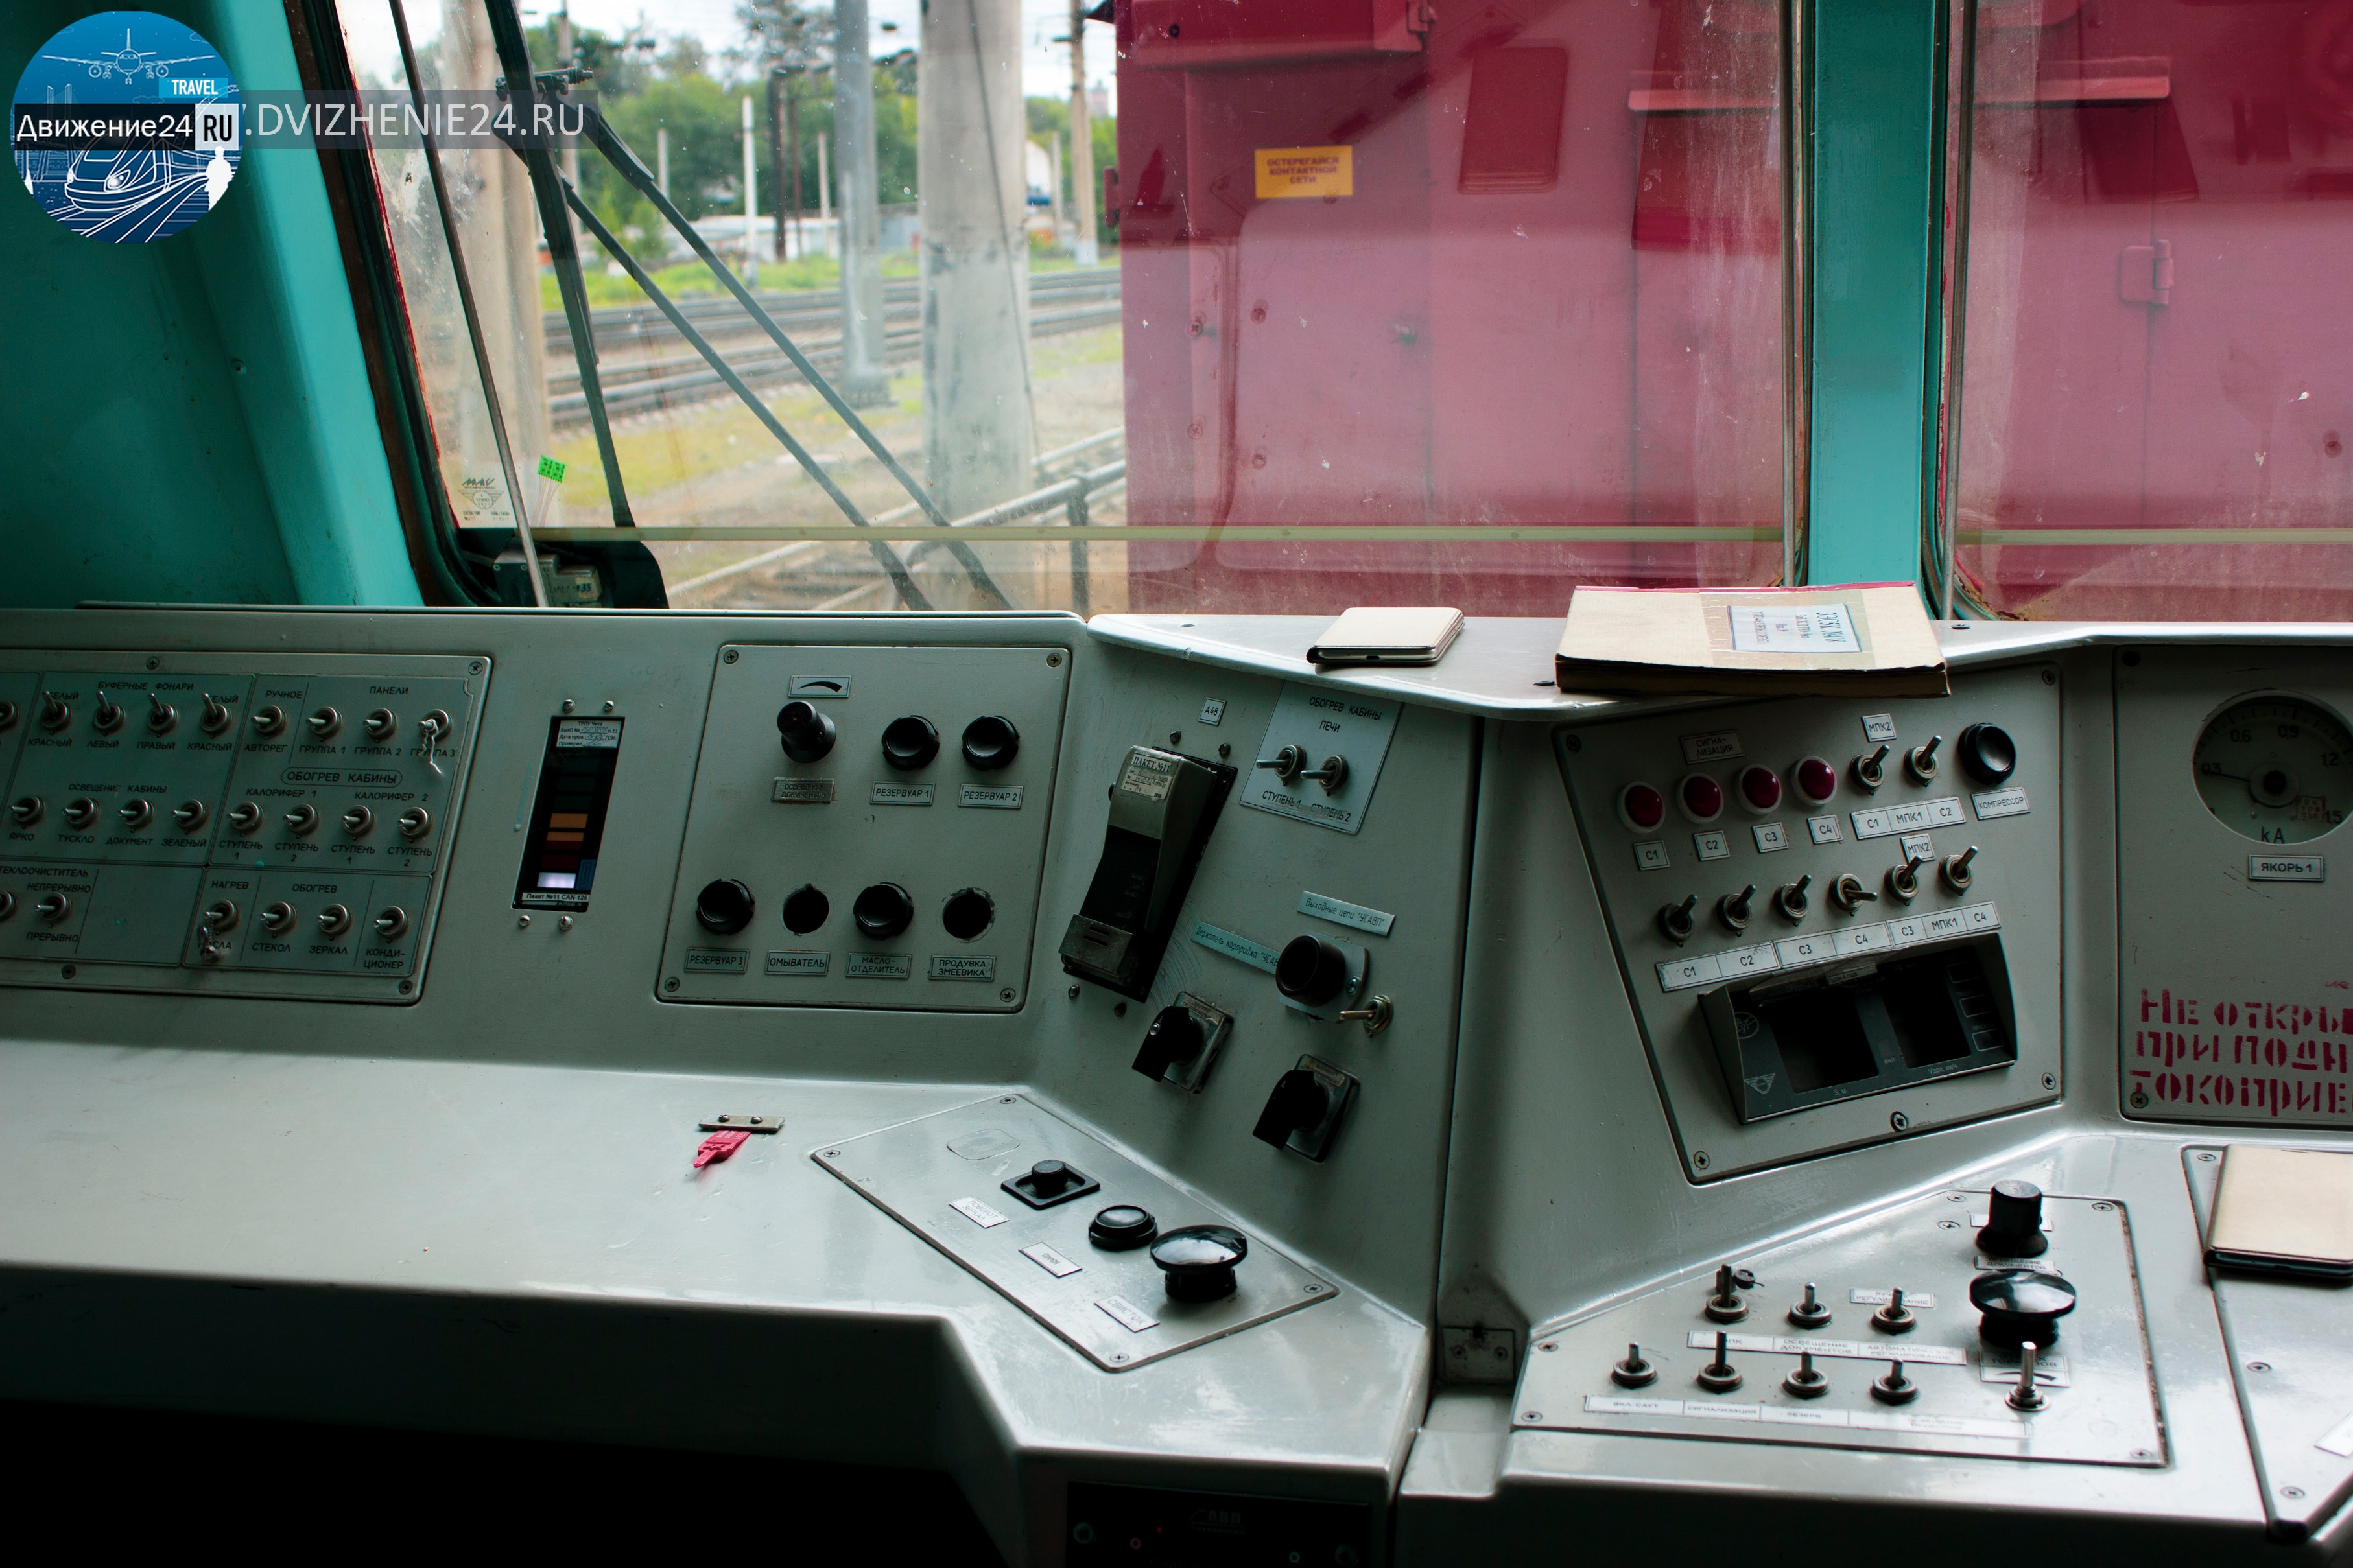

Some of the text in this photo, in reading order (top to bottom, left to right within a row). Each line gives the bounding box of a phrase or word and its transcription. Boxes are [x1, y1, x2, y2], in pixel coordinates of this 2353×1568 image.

[1267, 156, 1339, 166] ОСТЕРЕГАЙСЯ
[1270, 165, 1337, 175] КОНТАКТНОЙ
[98, 681, 195, 691] БУФЕРНЫЕ ФОНАРИ
[369, 686, 408, 695] ПАНЕЛИ
[266, 690, 303, 699] РУЧНОЕ
[1204, 707, 1219, 716] А48
[1309, 697, 1382, 720] ОБОГРЕВ КАБИНЫ
[1319, 720, 1341, 732] ПЕЧИ
[1868, 722, 1891, 732] МПК2
[2230, 729, 2251, 743] 0,6
[2278, 725, 2299, 739] 0,9
[28, 738, 73, 747] КРАСНЫЙ
[87, 739, 119, 748] ЛЕВЫЙ
[136, 740, 176, 750] ПРАВЫЙ
[187, 741, 233, 751] КРАСНЫЙ
[1696, 738, 1726, 747] СИГНА-
[244, 744, 289, 753] АВТОРЕГ.
[299, 745, 340, 755] ГРУППА
[355, 747, 402, 756] ГРУППА 2
[449, 749, 456, 758] 3
[1696, 745, 1734, 758] ЛИЗАЦИЯ
[1133, 756, 1170, 773] ПАКЕТ №11
[2321, 753, 2339, 769] 1,2
[287, 771, 397, 783] ОБОГРЕВ КАБИНЫ
[69, 784, 167, 793] ОСВЕЩЕНИЕ КАБИНЫ
[246, 788, 305, 798] КАЛОРИФЕР
[876, 788, 923, 797] РЕЗЕРВУАР
[355, 791, 414, 801] КАЛОРИФЕР
[964, 791, 1010, 801] РЕЗЕРВУАР
[1262, 790, 1295, 807] СТУПЕНЬ
[1978, 797, 2024, 809] КОМПРЕССОР
[1310, 803, 1351, 822] СТУПЕНЬ 2
[1939, 807, 1952, 816] С2
[1867, 818, 1879, 828] С1
[1895, 812, 1922, 824] МПК1
[1819, 824, 1832, 834] С4
[8, 832, 34, 841] ЯРКО
[58, 834, 95, 843] ТУСКЛО
[1764, 832, 1778, 842] С3
[106, 837, 153, 847] ДОКУМЕНТ
[161, 838, 207, 848] ЗЕЛЕНЫЙ
[219, 839, 263, 850] СТУПЕНЬ
[275, 842, 319, 852] СТУПЕНЬ
[1705, 839, 1719, 850] С2
[331, 844, 375, 854] СТУПЕНЬ
[388, 846, 432, 856] СТУПЕНЬ
[1907, 843, 1930, 854] МПК2
[290, 854, 296, 862] 2
[1646, 849, 1658, 861] С1
[2261, 863, 2312, 872] ЯКОРЬ 1
[27, 882, 91, 893] НЕПРЕРЫВНО
[211, 880, 249, 890] НАГРЕВ
[292, 883, 337, 894] ОБОГРЕВ
[1305, 898, 1385, 926] Выходные цепи "УСАВП"
[1974, 913, 1987, 922] С4
[1932, 919, 1958, 931] МПК1
[1901, 926, 1914, 936] С3
[26, 932, 79, 942] ПРЕРЫВНО
[1855, 935, 1868, 944] С4
[252, 942, 290, 952] СТЕКОЛ
[1196, 926, 1224, 945] Держатель
[1225, 939, 1258, 959] картриджа
[309, 946, 348, 955] ЗЕРКАЛ
[366, 948, 406, 958] КОНДИ-
[1799, 944, 1812, 955] С3
[364, 959, 404, 970] ЦИОНЕР
[689, 955, 743, 965] РЕЗЕРВУАР 3
[769, 958, 825, 968] ОМЫВАТЕЛЬ
[862, 957, 896, 965] МАСЛО-
[939, 959, 987, 968] ПРОДУВКА
[1740, 956, 1754, 966] С2
[851, 965, 905, 975] ОТДЕЛИТЕЛЬ
[938, 968, 985, 977] ЗМЕЕВИКА
[1683, 966, 1696, 977] С1
[2141, 988, 2199, 1025] НЕ
[2136, 1031, 2219, 1068] ПРИ
[962, 1205, 986, 1220] ЗЕРКАЛ
[969, 1200, 999, 1218] ПОВОРОТ
[1107, 1299, 1148, 1325] СВИСТОК
[1784, 1339, 1848, 1348] ОСВЕЩЕНИЕ
[1779, 1346, 1852, 1354] ДОКУМЕНТОВ
[1867, 1345, 1956, 1355] АВТОМАТИЧЕСКОЕ
[1870, 1351, 1952, 1360] РЕГУЛИРОВАНИЕ
[1688, 1405, 1756, 1415] СИГНАЛИЗАЦИЯ
